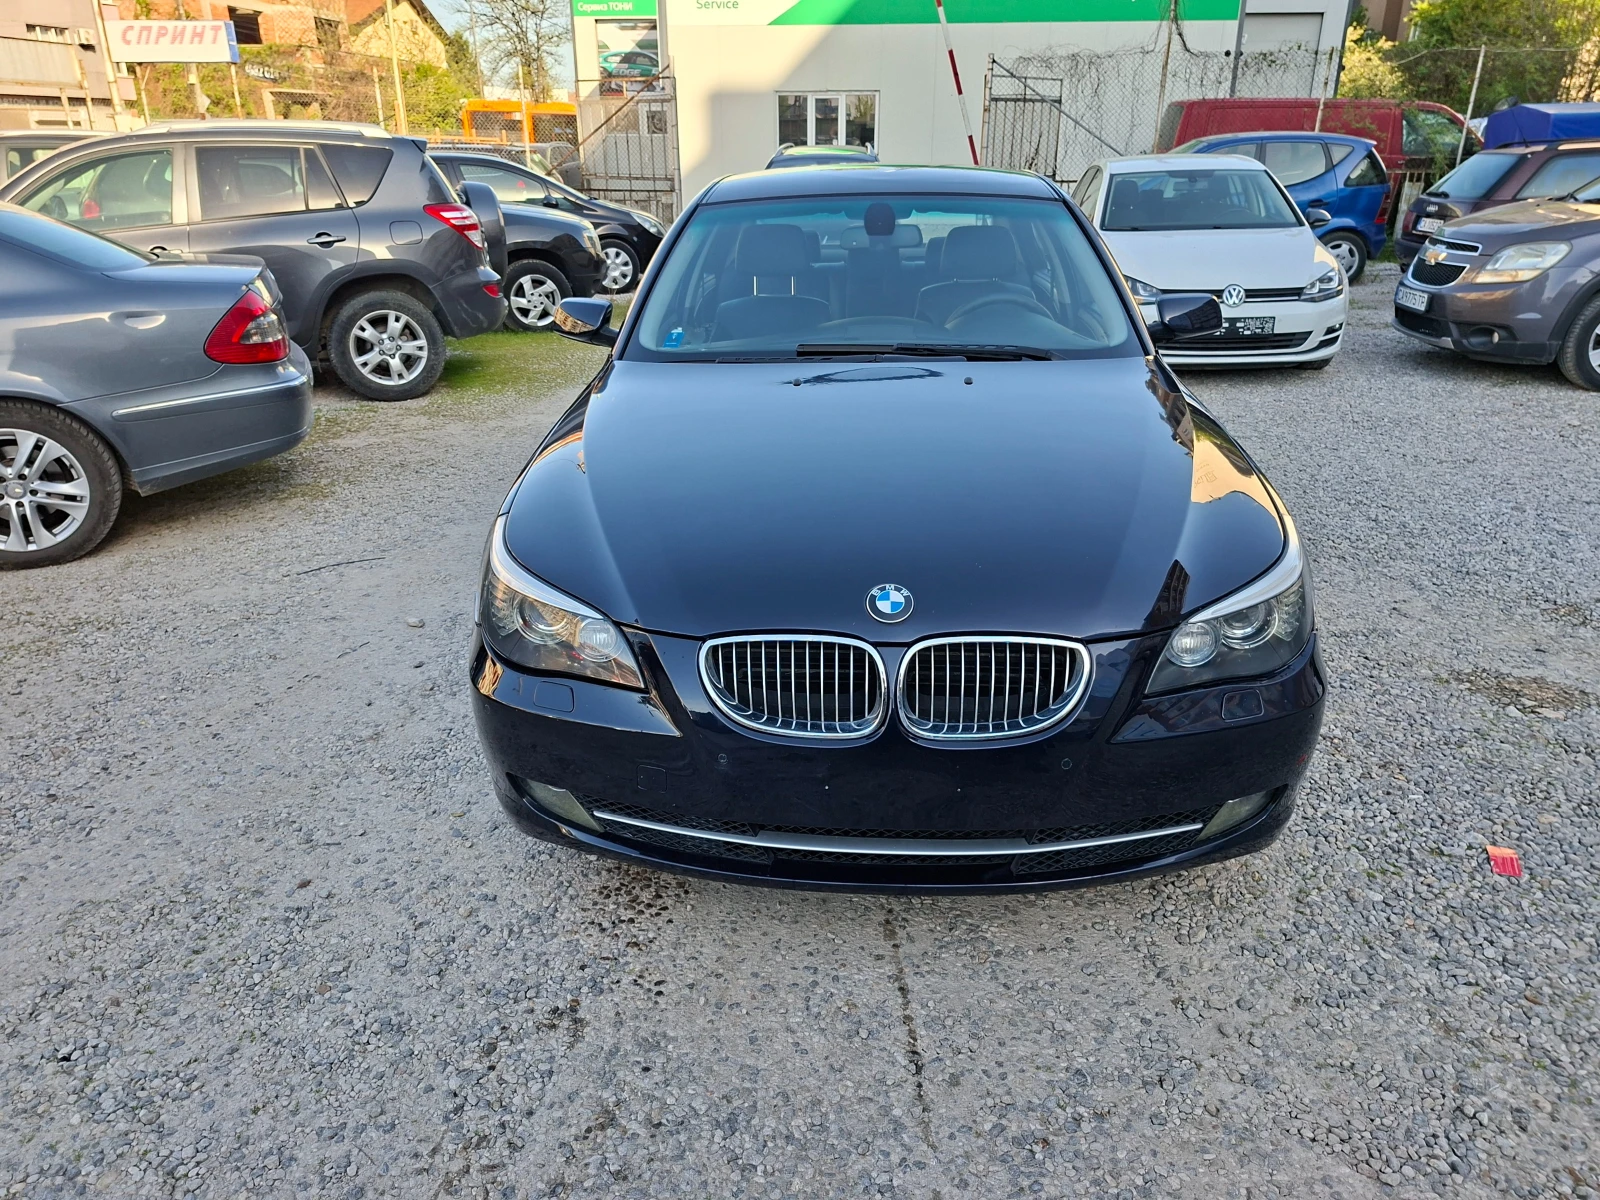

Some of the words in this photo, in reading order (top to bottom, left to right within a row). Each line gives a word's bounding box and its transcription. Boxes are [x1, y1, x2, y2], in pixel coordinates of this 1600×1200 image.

[608, 2, 633, 11] ТОНИ
[696, 0, 739, 9] Service
[121, 25, 222, 46] СПРИНТ
[612, 68, 641, 76] EDGE
[871, 584, 911, 597] BMW
